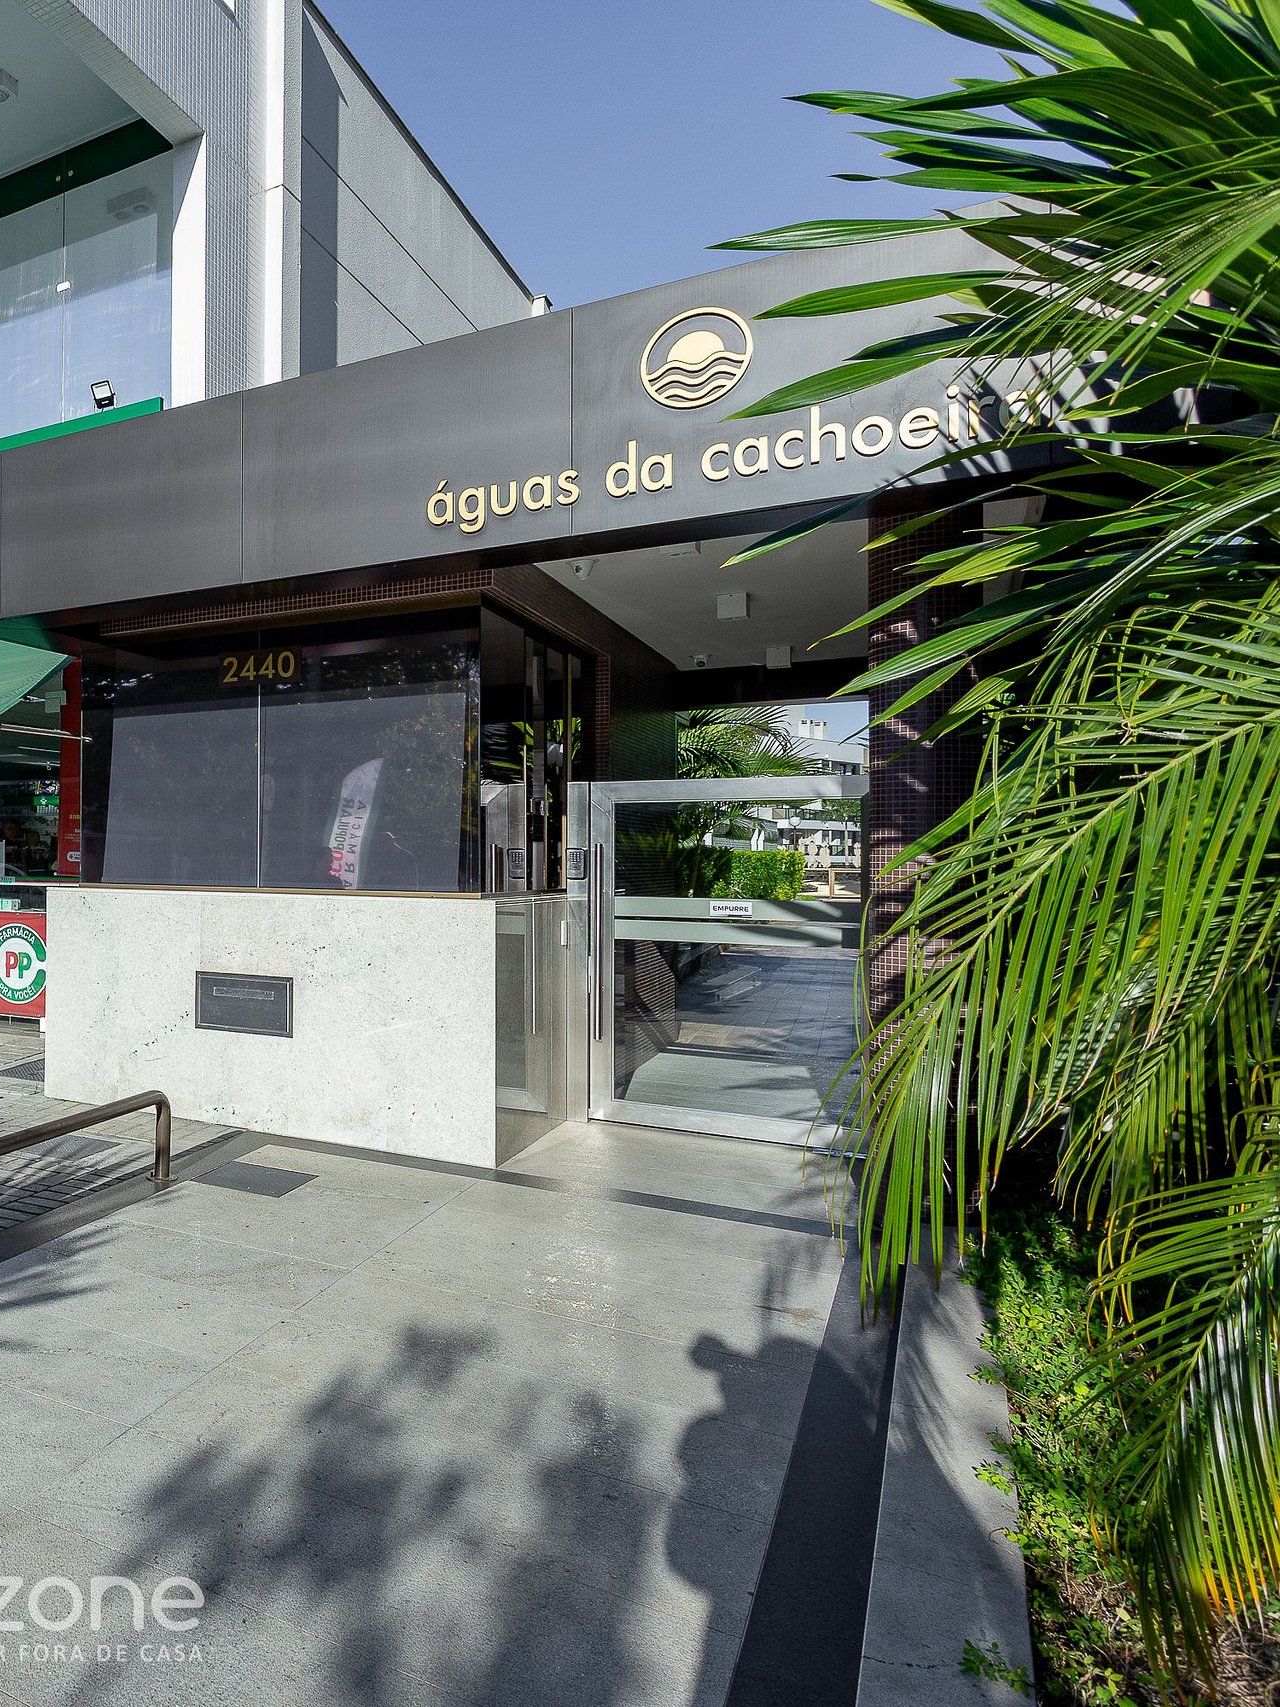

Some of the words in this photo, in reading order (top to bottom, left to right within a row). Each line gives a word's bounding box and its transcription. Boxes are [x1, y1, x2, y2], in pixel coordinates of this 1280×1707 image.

[427, 468, 581, 534] águas
[605, 439, 673, 498] da
[700, 384, 1042, 482] cachoeira
[223, 651, 295, 683] 2440
[5, 951, 32, 979] PP
